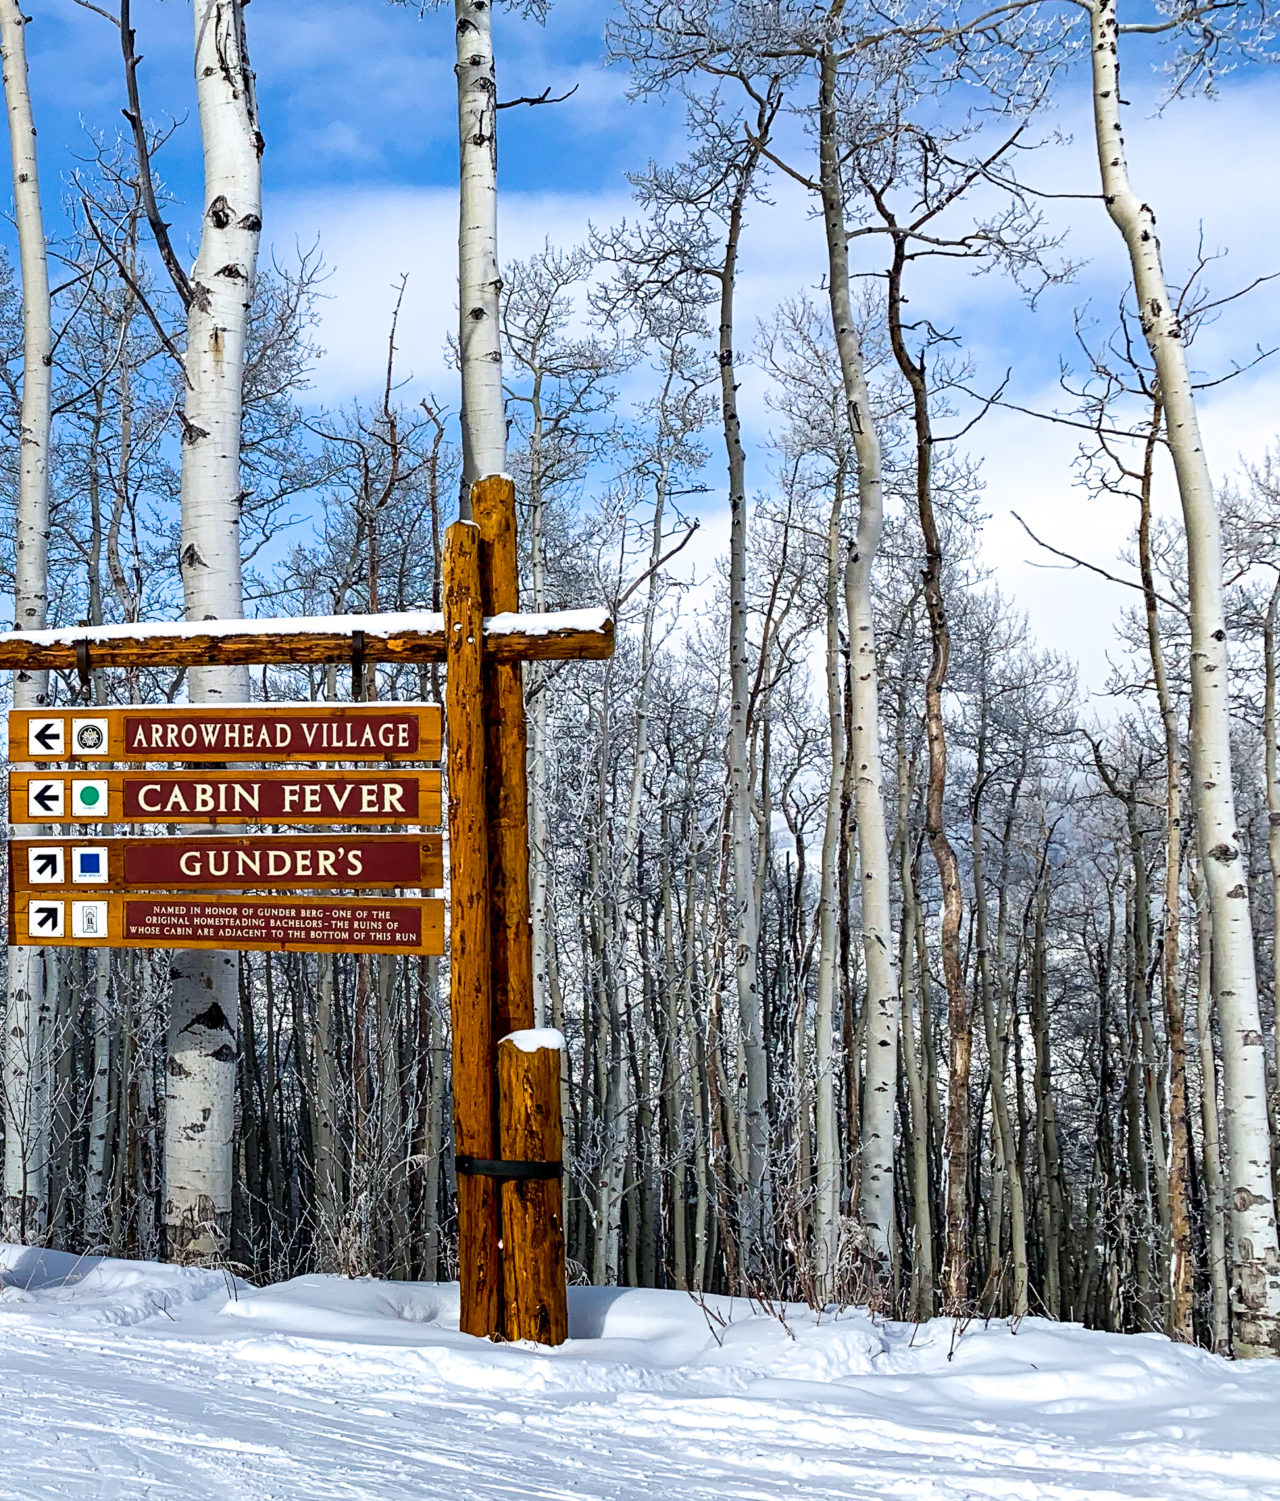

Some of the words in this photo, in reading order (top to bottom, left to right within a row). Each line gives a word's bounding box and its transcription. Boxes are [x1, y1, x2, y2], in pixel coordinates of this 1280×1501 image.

[132, 723, 291, 748] ARROWHEAD
[300, 723, 409, 748] VILLAGE
[138, 784, 261, 812] CABIN
[282, 783, 406, 813] FEVER
[179, 847, 363, 876] GUNDER'S
[153, 905, 186, 915] NAMED
[190, 906, 201, 915] IN
[205, 907, 238, 916] HONOR
[241, 907, 254, 916] OF
[257, 908, 296, 917] GUNDER
[355, 910, 368, 919] OF
[372, 910, 391, 919] THE
[145, 916, 190, 925] ORIGINAL
[193, 917, 265, 927] HOMESTEADING
[353, 921, 382, 930] RUINS
[386, 921, 399, 930] OF
[129, 926, 160, 935] WHOSE
[164, 927, 193, 936] CABIN
[196, 928, 215, 936] ARE
[218, 929, 267, 938] ADJACENT
[271, 929, 284, 938] TO
[288, 930, 306, 939] THE
[310, 930, 349, 940] BOTTOM
[353, 931, 366, 940] OF
[370, 932, 391, 941] THIS
[395, 932, 417, 942] RUN
